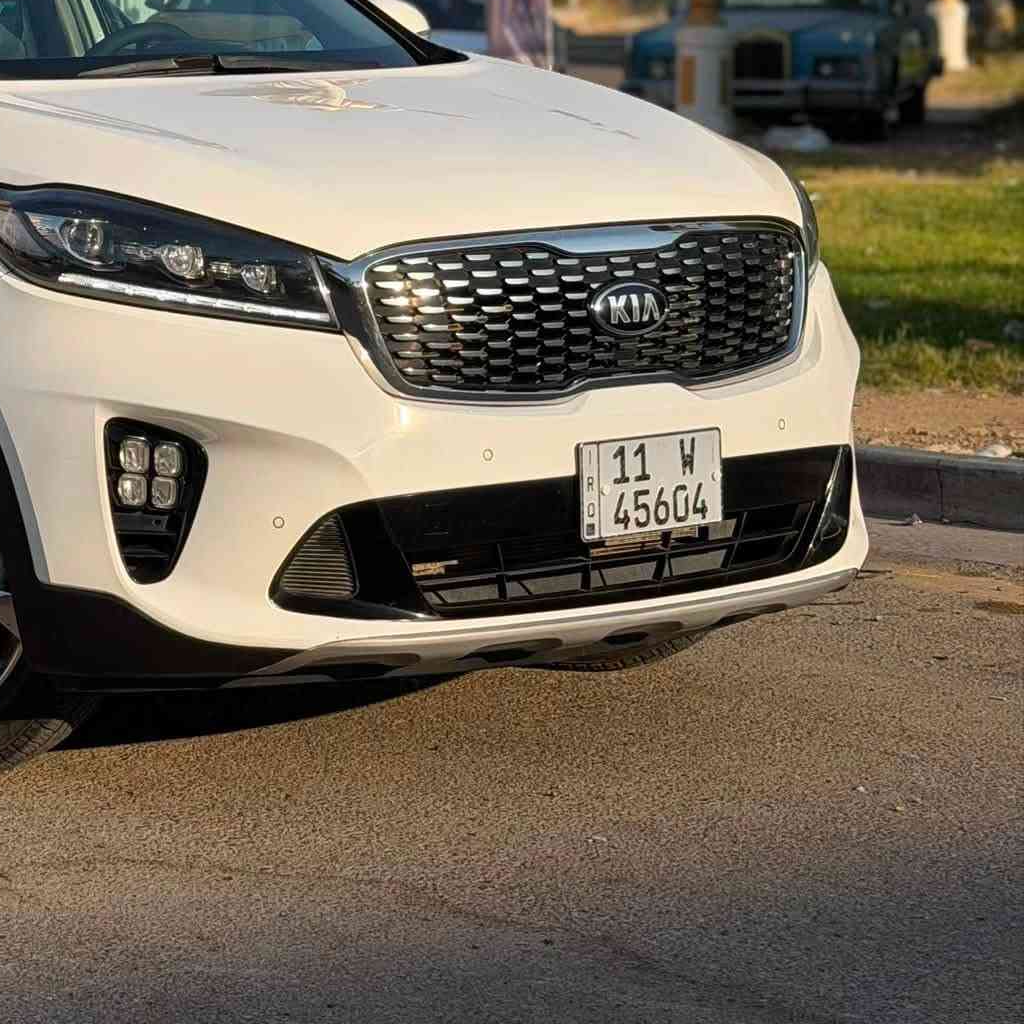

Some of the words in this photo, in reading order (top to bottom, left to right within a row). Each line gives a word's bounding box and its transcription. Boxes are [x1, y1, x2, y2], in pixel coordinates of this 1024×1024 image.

[607, 291, 661, 325] KIA
[612, 442, 652, 485] 11
[678, 436, 696, 476] W
[613, 482, 709, 529] 45604
